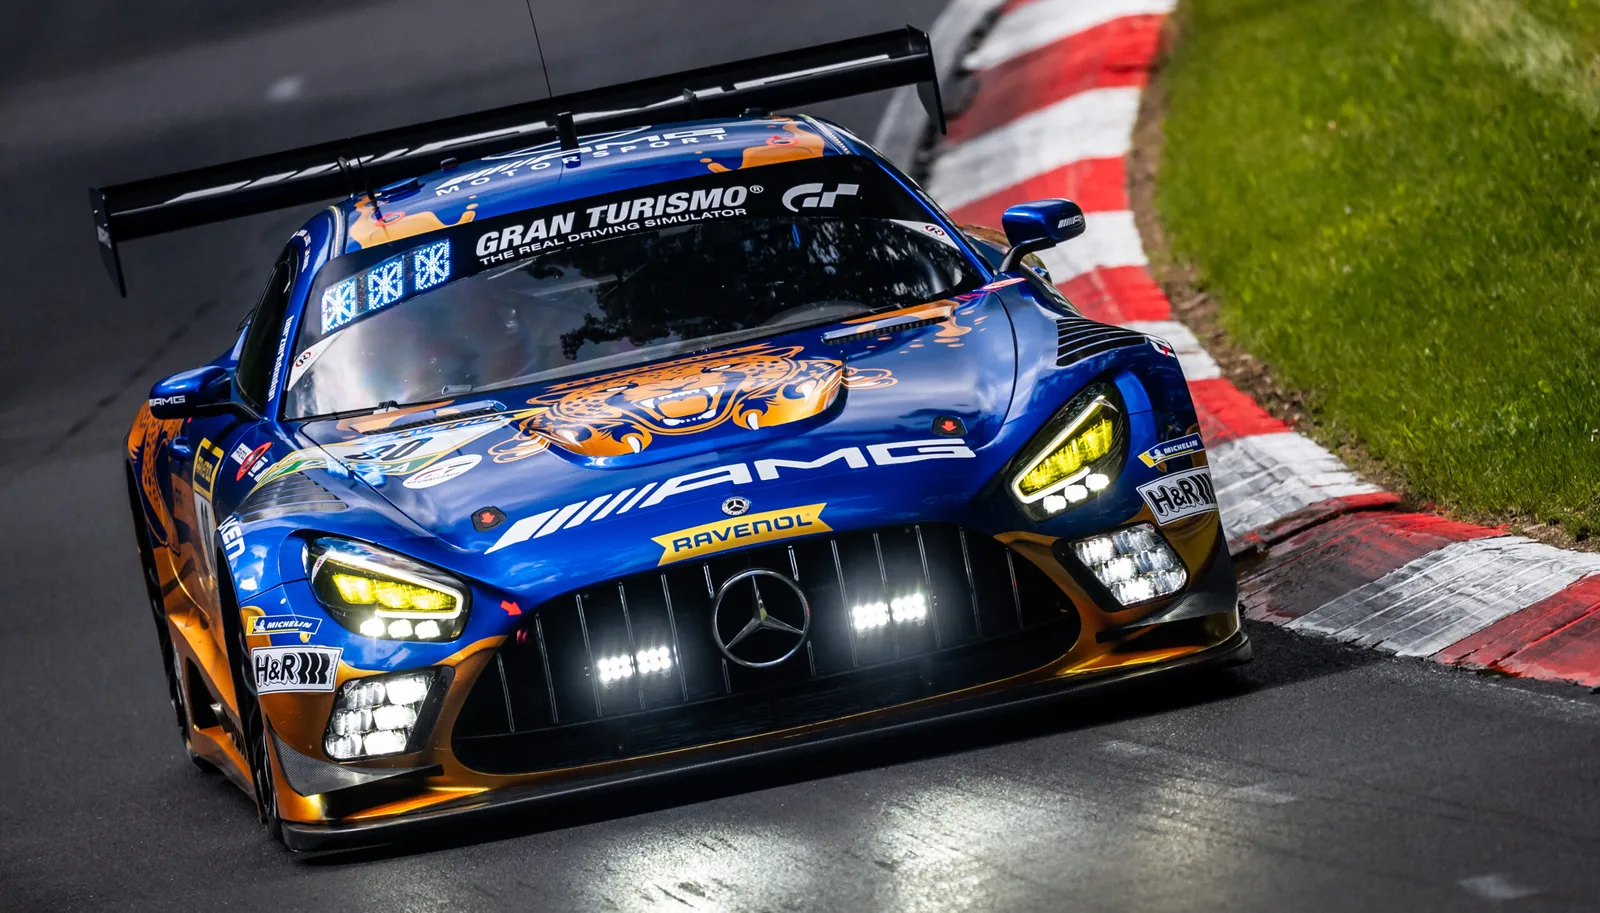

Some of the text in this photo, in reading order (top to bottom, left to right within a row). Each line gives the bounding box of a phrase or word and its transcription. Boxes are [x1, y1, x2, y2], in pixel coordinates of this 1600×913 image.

[435, 133, 728, 197] MOTORSPORT
[476, 212, 576, 257] GRAN
[480, 208, 748, 266] THE REAL DRIVING SIMULATOR
[153, 395, 186, 407] AMG
[1163, 440, 1198, 454] MICHELIN
[644, 438, 976, 508] AMG
[1148, 478, 1200, 513] H&R
[672, 514, 813, 552] RAVENOL
[266, 620, 313, 628] MICHELIN
[256, 652, 296, 685] H&R
